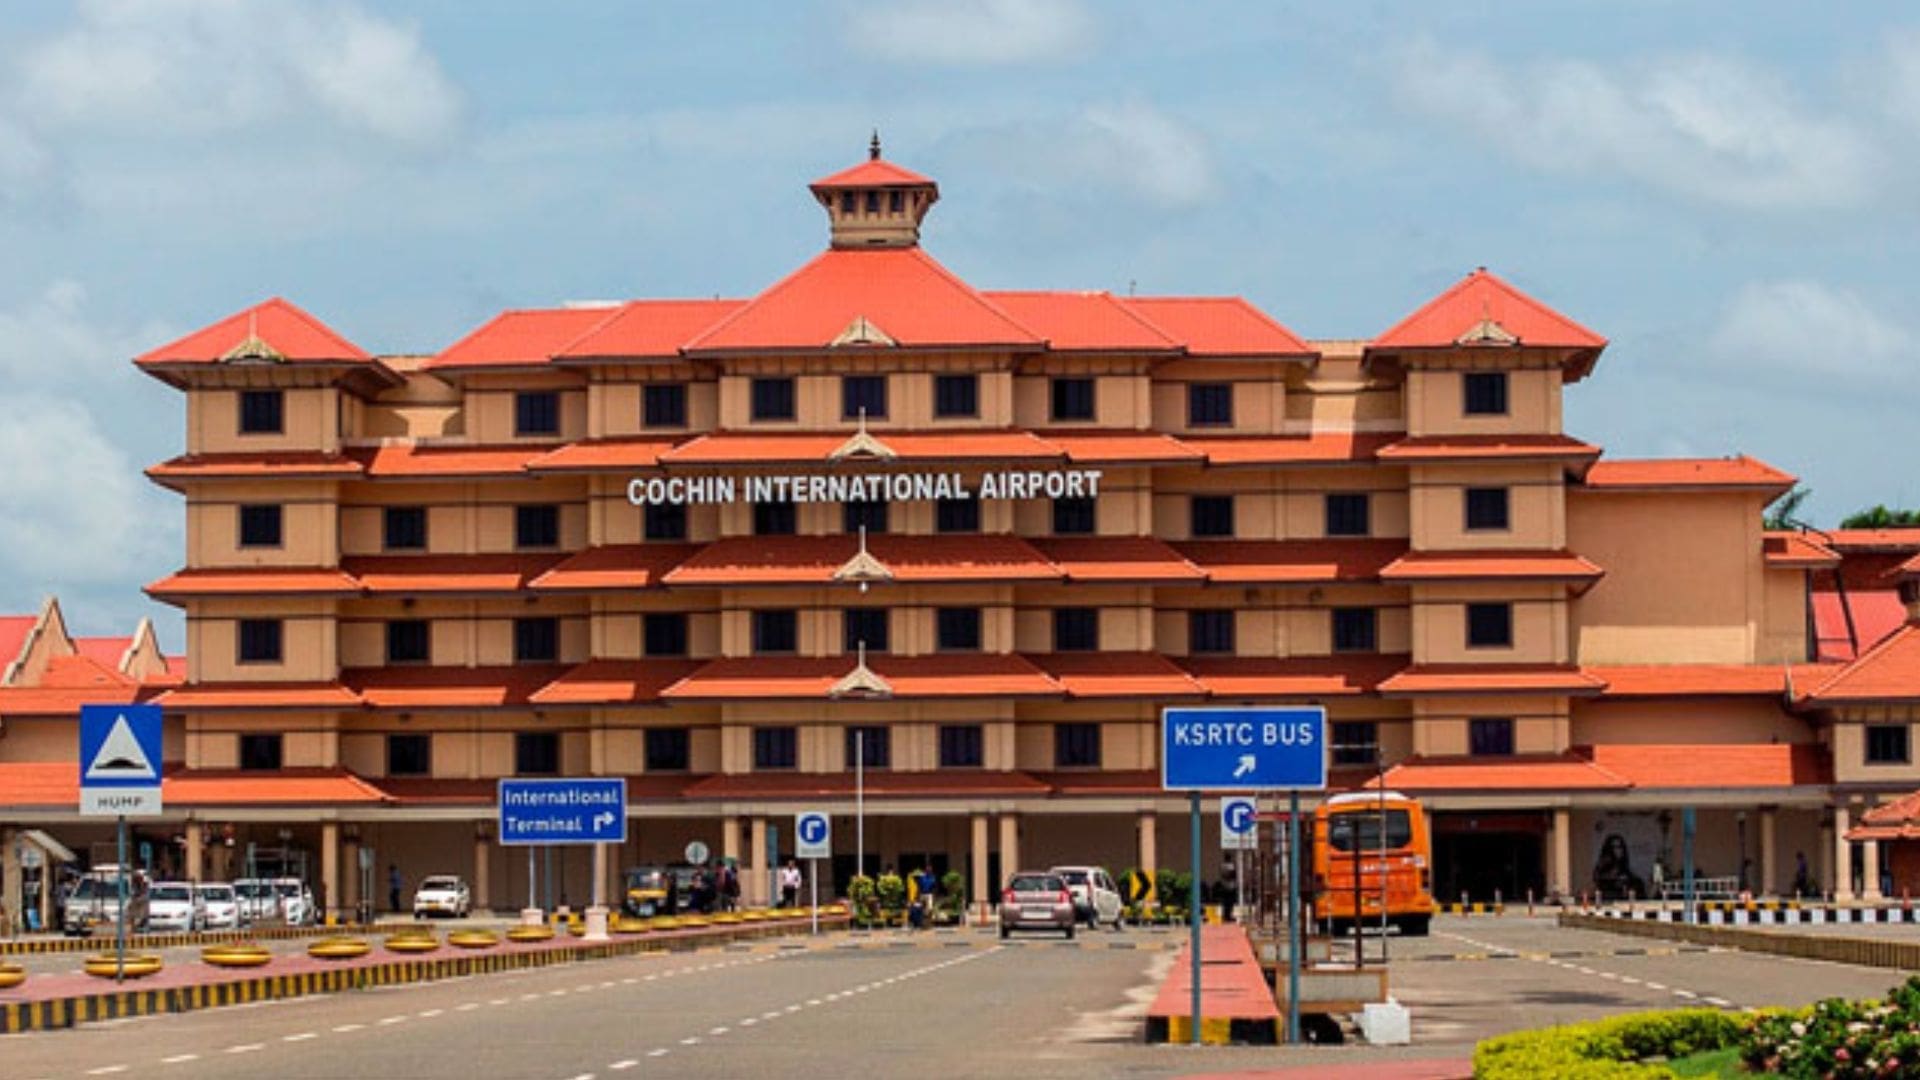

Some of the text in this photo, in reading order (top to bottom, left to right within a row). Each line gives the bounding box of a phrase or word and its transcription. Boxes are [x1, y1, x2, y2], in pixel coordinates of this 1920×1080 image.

[627, 470, 1102, 505] COCHIN INTERNATIONAL AIRPORT
[1174, 722, 1314, 746] KSRTC BUS
[97, 796, 144, 809] HUMP
[505, 788, 619, 806] International
[506, 815, 583, 833] Terminal
